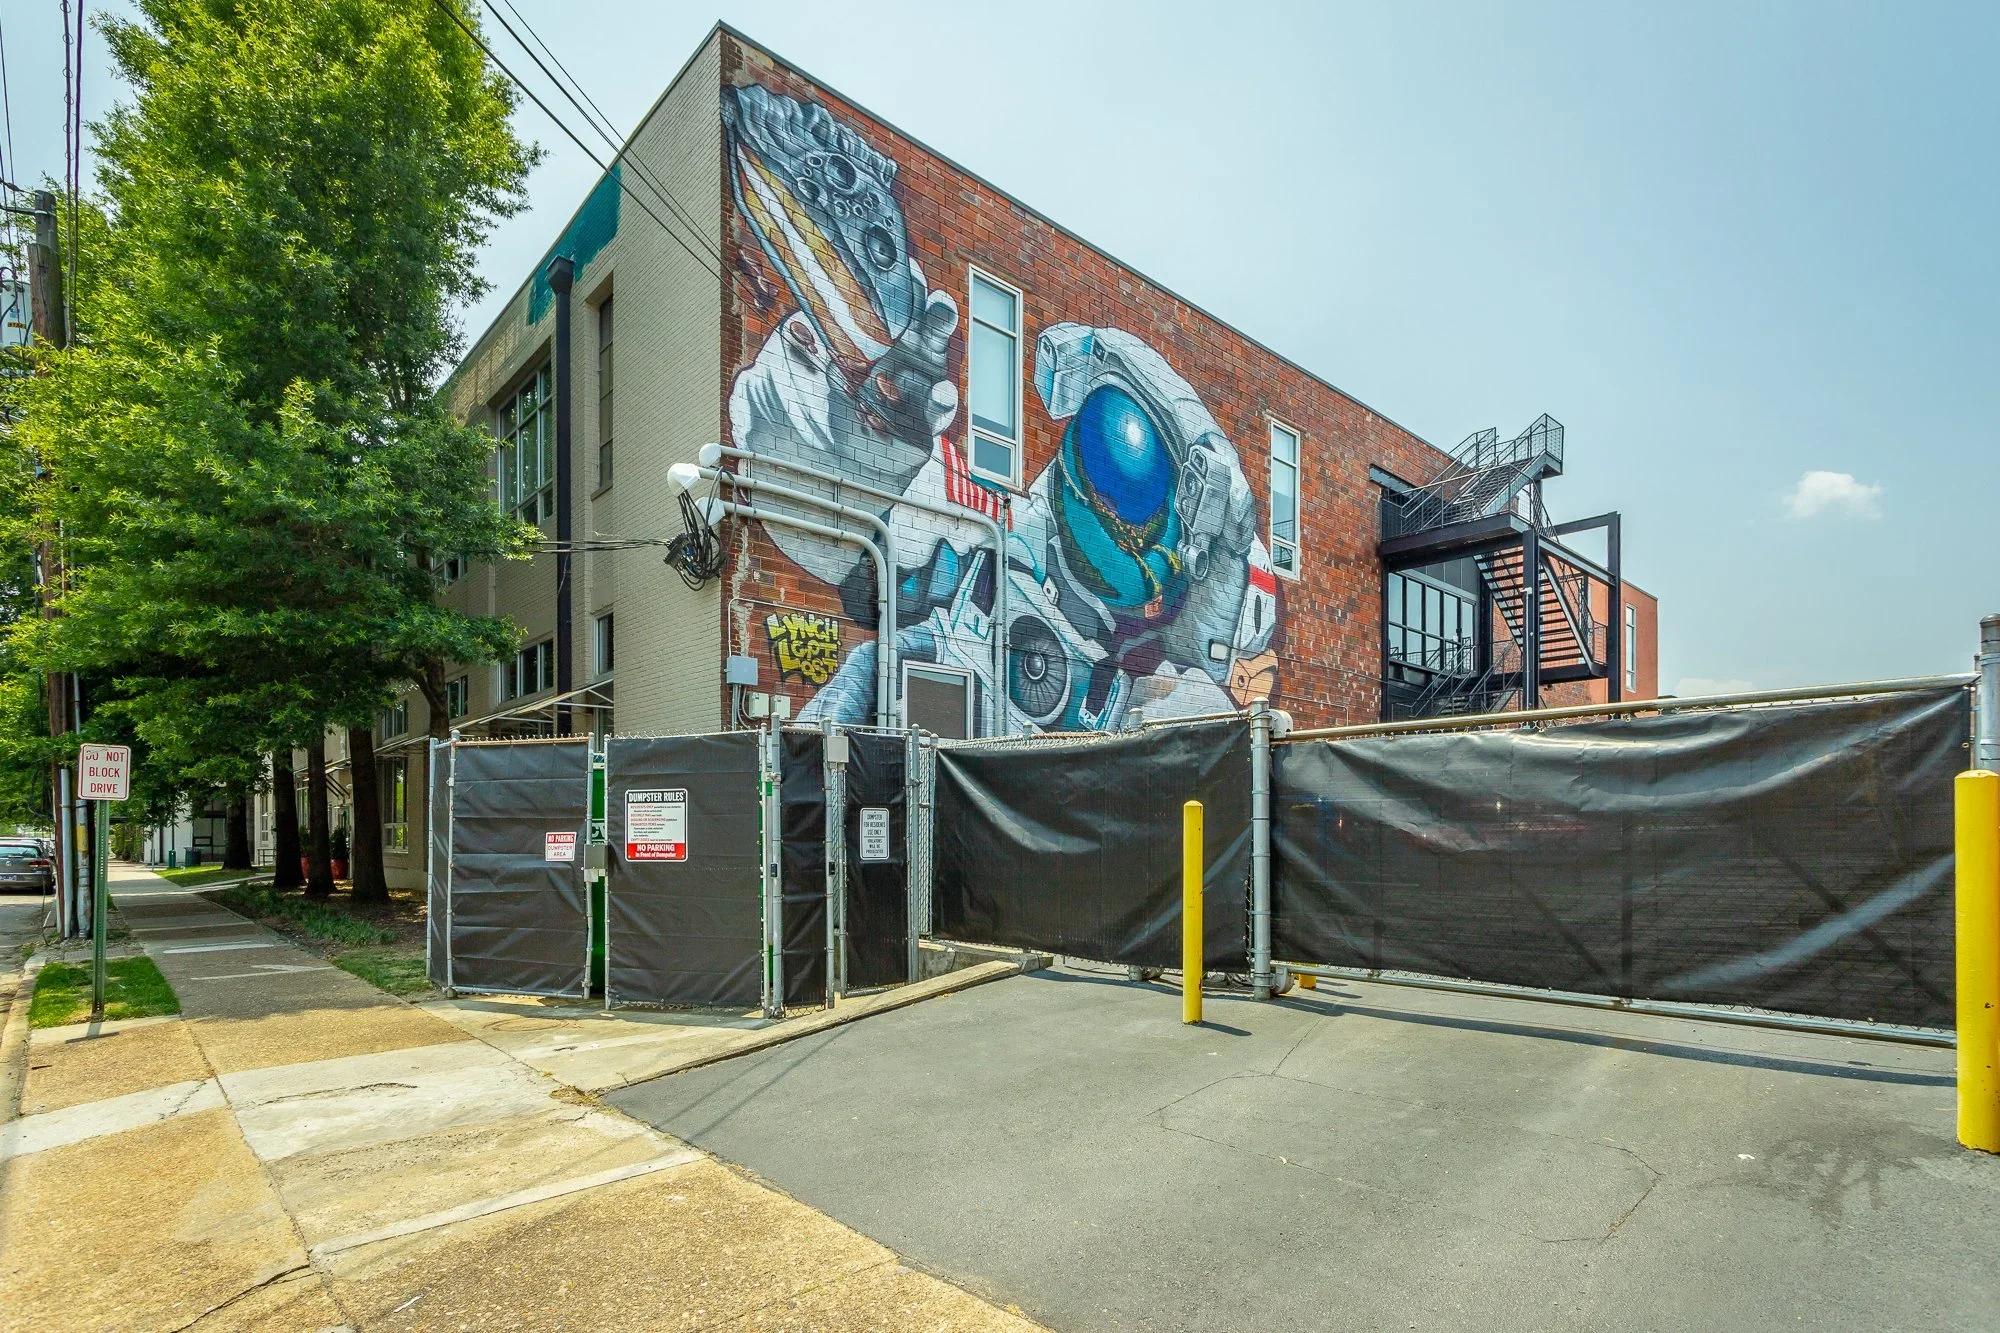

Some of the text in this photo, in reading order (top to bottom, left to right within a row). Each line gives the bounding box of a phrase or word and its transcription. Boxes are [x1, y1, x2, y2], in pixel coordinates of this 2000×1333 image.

[86, 750, 125, 762] DO NOT
[89, 767, 120, 777] BLOCK
[90, 783, 118, 793] DRIVE
[628, 792, 684, 802] DUMPSTER RULES
